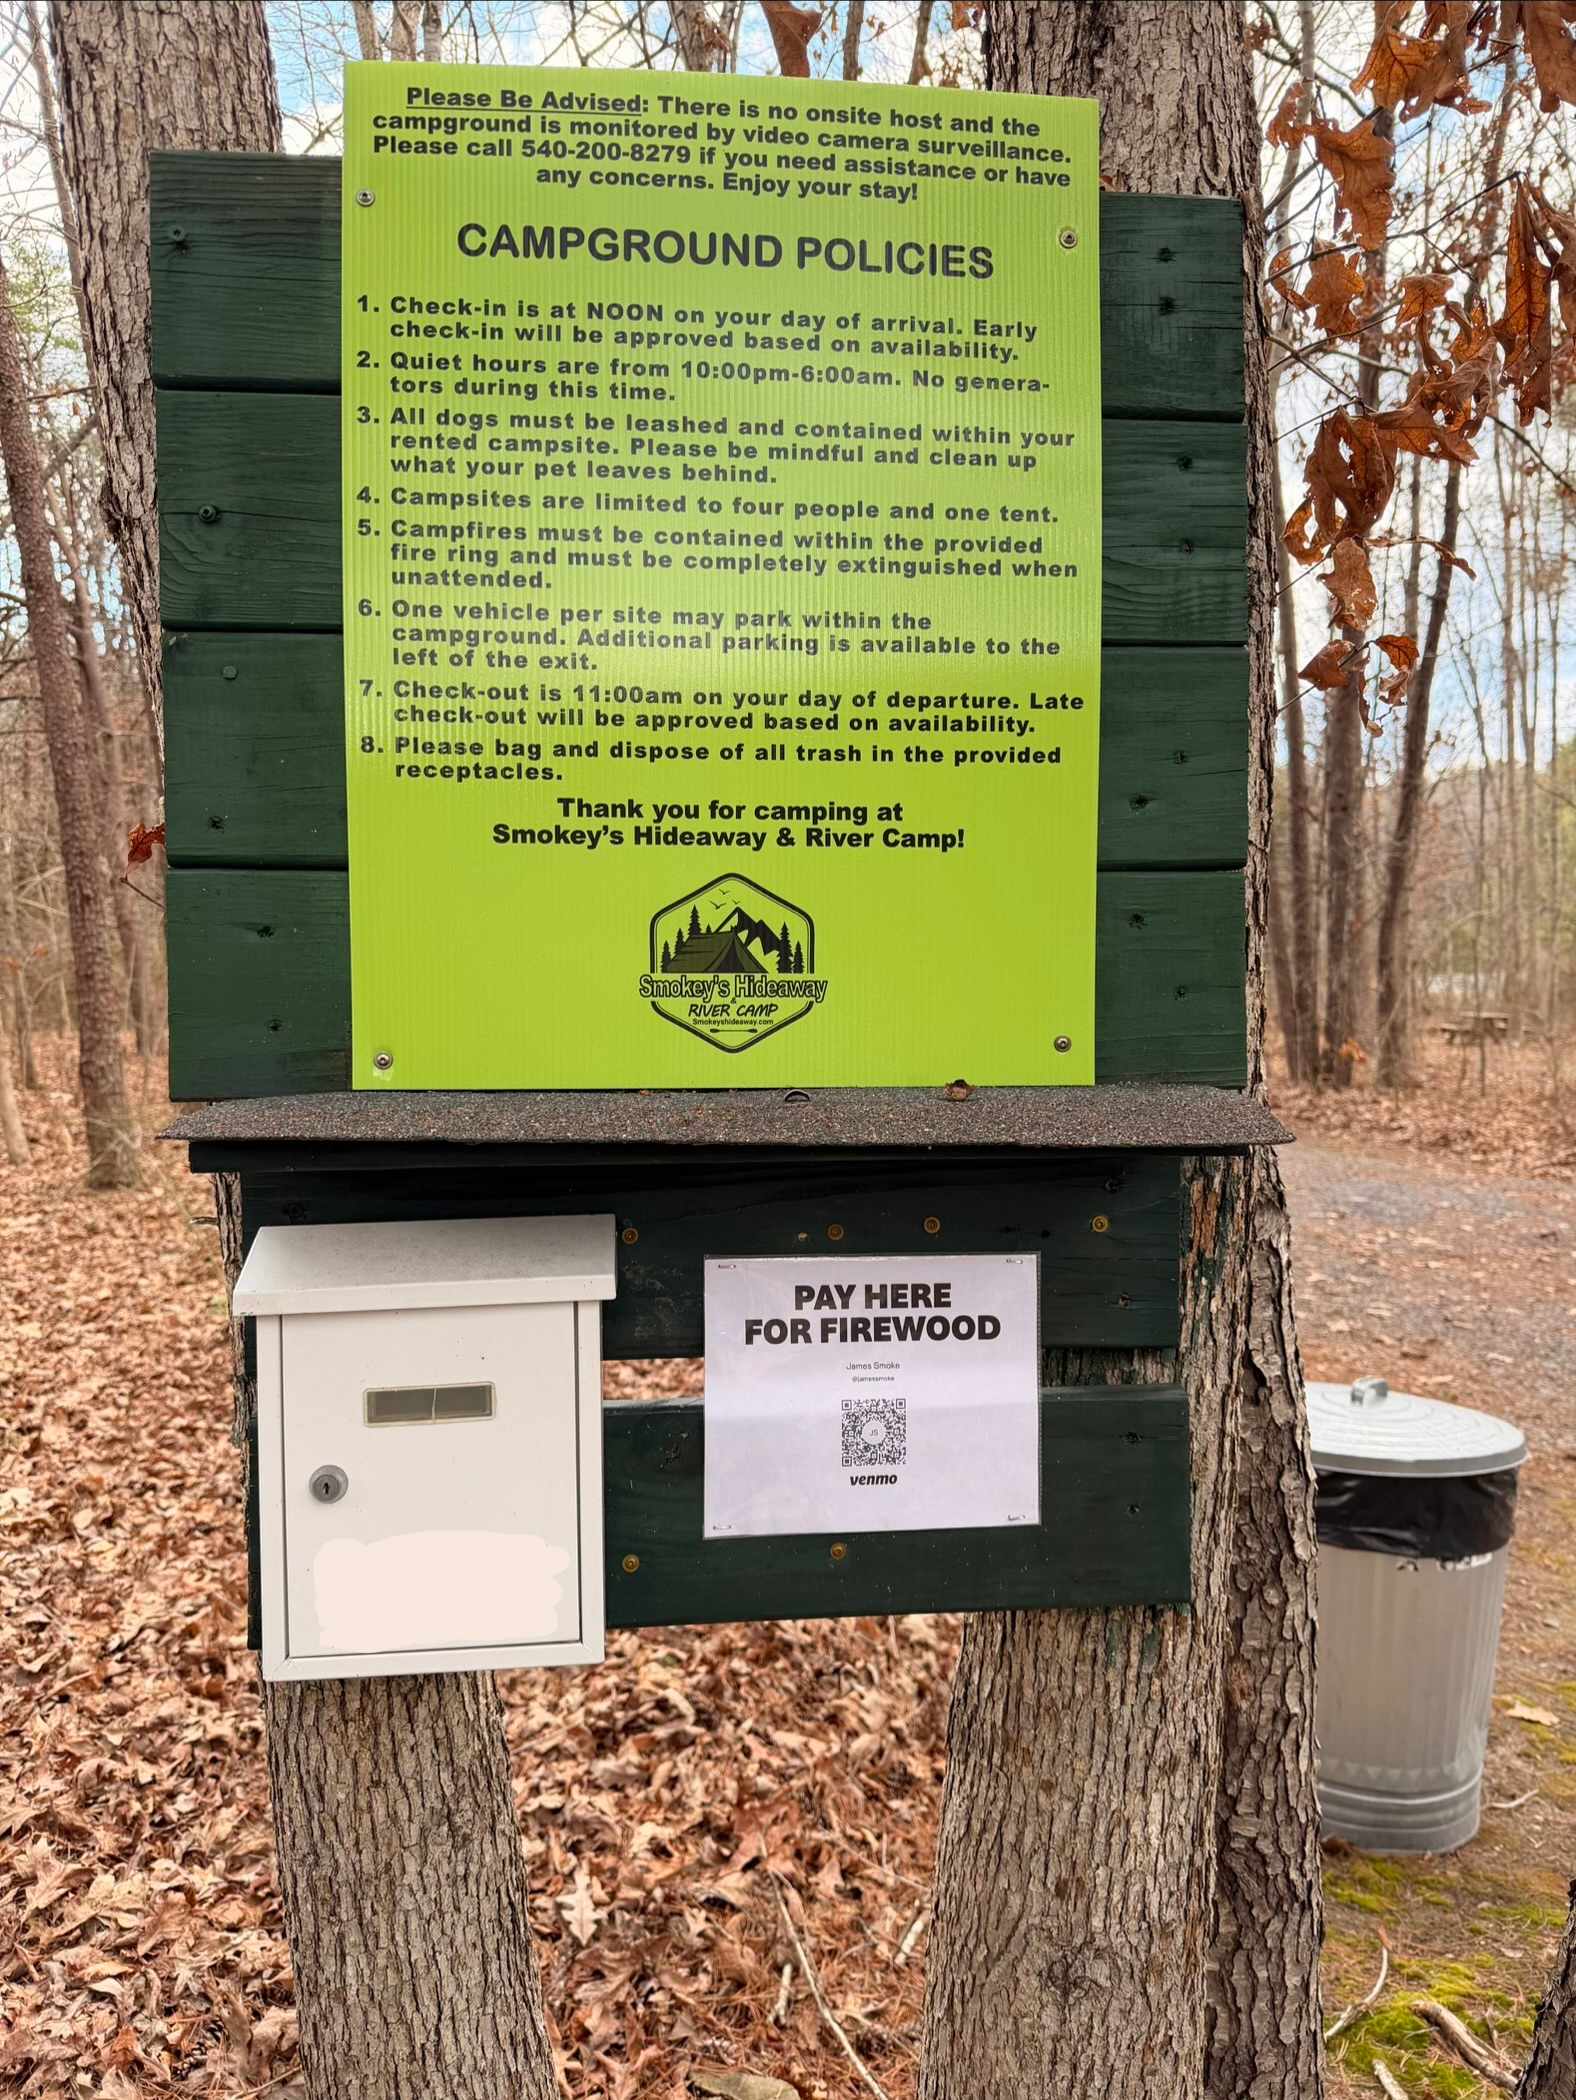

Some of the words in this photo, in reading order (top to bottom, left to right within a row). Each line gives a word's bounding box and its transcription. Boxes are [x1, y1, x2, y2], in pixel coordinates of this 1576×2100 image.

[407, 87, 491, 109] Please
[500, 90, 533, 109] Be
[541, 91, 649, 113] Advised:
[657, 95, 731, 117] There
[739, 99, 760, 118] is
[768, 105, 798, 120] no
[806, 106, 882, 126] onsite
[890, 108, 942, 130] host
[950, 115, 993, 134] and
[1001, 118, 1040, 137] the
[372, 114, 531, 135] campground
[540, 115, 561, 134] is
[570, 118, 698, 140] monitored
[707, 122, 736, 146] by
[742, 125, 810, 146] video
[817, 133, 909, 152] camera
[918, 139, 1071, 163] surveillance.
[374, 135, 458, 155] Please
[466, 138, 512, 157] call
[521, 139, 691, 164] 540-200-8279
[699, 146, 717, 165] if
[724, 152, 768, 171] you
[777, 153, 836, 171] need
[844, 156, 976, 180] assistance
[983, 168, 1009, 182] or
[1015, 165, 1071, 187] have
[536, 169, 582, 188] any
[589, 171, 714, 189] concerns.
[723, 172, 791, 198] Enjoy
[797, 180, 852, 199] your
[859, 180, 918, 204] stay!
[457, 223, 783, 268] CAMPGROUND
[797, 236, 994, 280] POLICIES
[357, 294, 379, 313] 1.
[390, 296, 506, 317] Check-in
[518, 300, 539, 318] is
[550, 302, 576, 319] at
[587, 302, 663, 322] NOON
[674, 309, 704, 323] on
[715, 311, 771, 329] your
[781, 310, 826, 333] day
[836, 312, 861, 330] of
[871, 315, 963, 335] arrival.
[974, 318, 1037, 343] Early
[356, 350, 380, 368] 2.
[390, 351, 462, 371] Quiet
[473, 353, 547, 373] hours
[557, 360, 600, 375] are
[610, 358, 669, 377] from
[681, 360, 901, 386] 10:00pm-6:00am.
[913, 369, 944, 388] No
[955, 376, 1050, 393] genera-
[390, 376, 443, 394] tors
[454, 377, 538, 401] during
[548, 380, 598, 399] this
[609, 382, 675, 401] time.
[356, 406, 380, 424] 3.
[390, 407, 425, 425] All
[436, 408, 498, 432] dogs
[510, 412, 574, 430] must
[585, 412, 615, 431] be
[626, 414, 727, 434] leashed
[738, 419, 784, 436] and
[795, 422, 922, 441] contained
[932, 425, 1011, 444] within
[1020, 432, 1075, 449] your
[390, 455, 456, 474] what
[466, 461, 524, 479] your
[535, 460, 576, 480] pet
[587, 460, 671, 480] leaves
[682, 463, 776, 483] behind.
[356, 486, 380, 504] 4.
[391, 486, 531, 511] Campsites
[542, 495, 584, 510] are
[596, 493, 686, 513] limited
[697, 496, 722, 514] to
[732, 496, 784, 516] four
[794, 500, 879, 522] people
[889, 502, 934, 520] and
[945, 507, 990, 521] one
[1000, 505, 1058, 523] tent.
[357, 518, 380, 536] 5.
[391, 519, 527, 543] Campfires
[538, 526, 602, 543] must
[613, 525, 643, 544] be
[654, 529, 783, 548] contained
[794, 531, 873, 550] within
[883, 533, 924, 552] the
[934, 536, 1042, 556] provided
[392, 569, 551, 589] unattended.
[358, 598, 381, 617] 6.
[392, 599, 443, 618] One
[453, 602, 549, 621] vehicle
[561, 608, 603, 626] per
[613, 606, 662, 624] site
[673, 611, 724, 630] may
[735, 610, 792, 631] park
[802, 610, 881, 629] within
[891, 612, 931, 630] the
[393, 647, 438, 666] left
[449, 649, 475, 667] of
[485, 650, 528, 669] the
[539, 652, 597, 670] exit.
[359, 679, 382, 697] 7.
[393, 680, 529, 701] Check-out
[540, 684, 562, 702] is
[573, 684, 682, 704] 11:00am
[693, 691, 722, 705] on
[733, 692, 789, 710] your
[798, 689, 842, 712] day
[852, 690, 877, 708] of
[886, 691, 1019, 713] departure.
[1030, 692, 1084, 710] Late
[360, 735, 384, 754] 8.
[395, 736, 484, 756] Please
[495, 738, 541, 762] bag
[552, 740, 599, 758] and
[609, 740, 710, 763] dispose
[719, 742, 745, 760] of
[755, 743, 785, 761] all
[795, 744, 861, 762] trash
[872, 744, 894, 762] in
[903, 745, 944, 763] the
[954, 746, 1061, 767] provided
[395, 761, 562, 783] receptacles.
[557, 797, 644, 819] Thank
[652, 803, 700, 824] you
[708, 799, 747, 820] for
[754, 801, 868, 826] camping
[877, 802, 903, 822] at
[493, 823, 624, 850] Smokey's
[634, 825, 767, 852] Hideaway
[776, 826, 796, 847] &
[806, 827, 875, 848] River
[882, 827, 964, 853] Camp!
[638, 974, 730, 1003] Smokey's
[734, 975, 828, 1003] Hideaway
[688, 1004, 730, 1017] RIVER
[736, 1004, 778, 1017] CAMP
[692, 1018, 774, 1026] Smokeyshideaway.com
[794, 1285, 856, 1310] PAY
[864, 1283, 952, 1309] HERE
[745, 1318, 812, 1345] FOR
[820, 1315, 1001, 1343] FIREWOOD
[846, 1361, 872, 1370] James
[873, 1361, 900, 1370] Smoke
[849, 1474, 898, 1486] venmo
